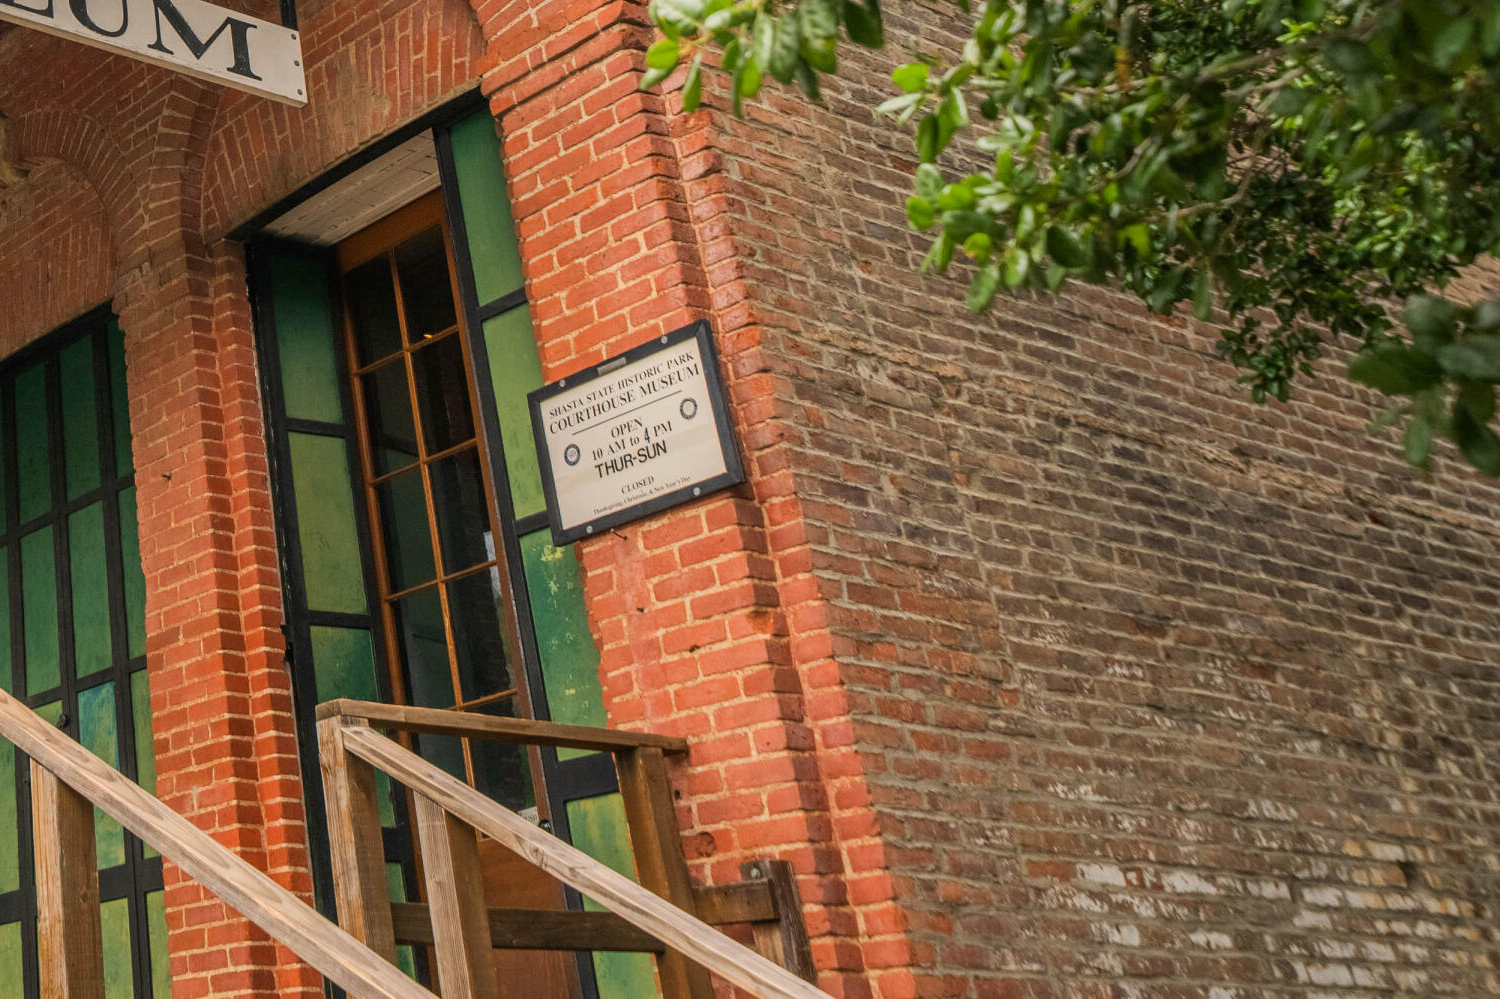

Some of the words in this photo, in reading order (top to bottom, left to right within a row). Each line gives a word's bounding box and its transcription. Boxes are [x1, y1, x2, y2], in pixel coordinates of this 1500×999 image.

[549, 398, 584, 418] SHASTA
[586, 384, 616, 404] STATE
[618, 364, 664, 390] HISTORIC
[666, 351, 694, 369] PARK
[550, 390, 636, 434] COURTHOUSE
[640, 363, 700, 397] MUSEUM
[592, 448, 603, 461] 10
[608, 439, 626, 456] AM
[630, 436, 640, 447] to
[644, 427, 651, 443] 4
[653, 421, 672, 437] PM
[611, 417, 643, 438] OPEN
[595, 440, 667, 478] THUR-SUN
[621, 475, 655, 494] CLOSED
